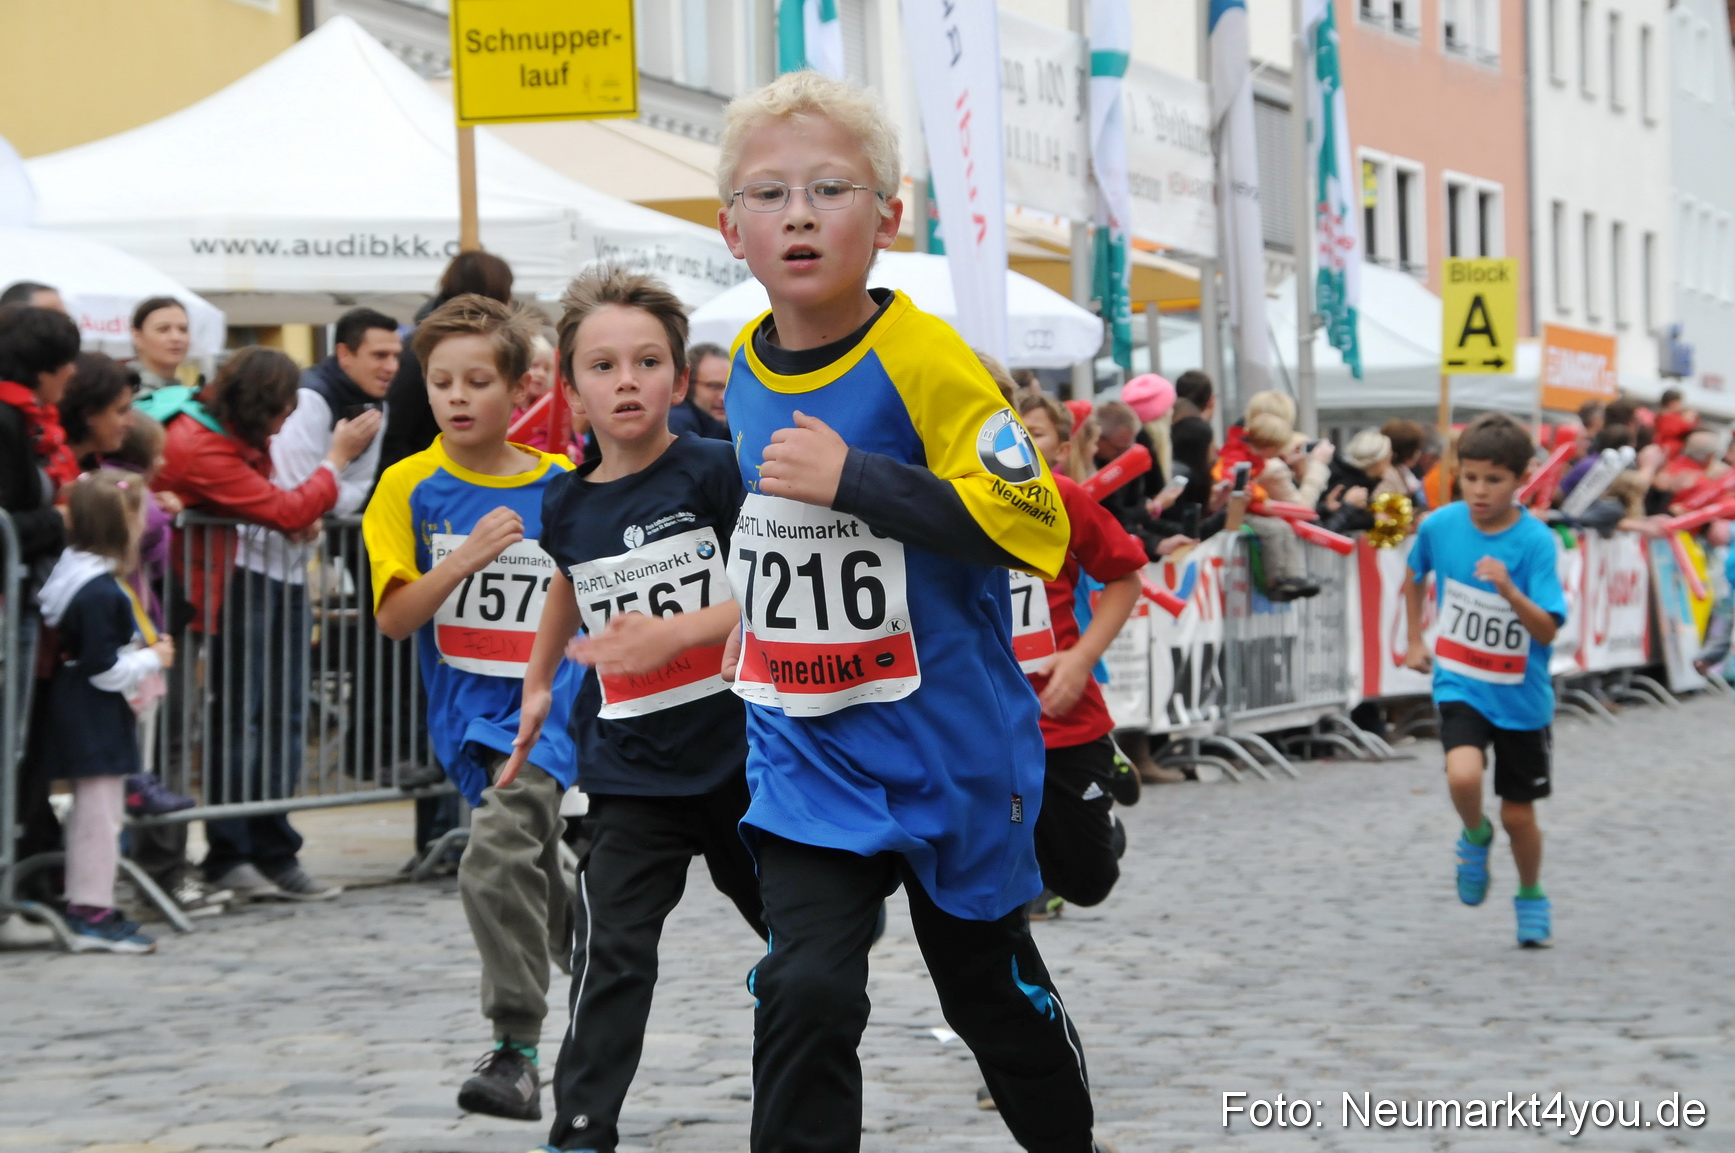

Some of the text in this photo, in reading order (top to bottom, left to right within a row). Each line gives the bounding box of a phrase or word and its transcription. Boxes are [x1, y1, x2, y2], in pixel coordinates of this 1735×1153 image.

[465, 27, 622, 54] Schnupper-
[520, 61, 569, 87] lauf
[190, 234, 484, 257] www.audibkk.
[1448, 262, 1511, 284] Block
[1457, 294, 1498, 347] A
[982, 410, 1029, 442] BMW
[991, 478, 1057, 527] Neumarkt
[766, 519, 859, 540] Neumarkt
[494, 553, 552, 568] eumarkt
[577, 551, 692, 596] PARTL Neumarkt
[739, 548, 886, 631] 7216
[891, 621, 900, 631] K
[1451, 603, 1523, 650] 7066
